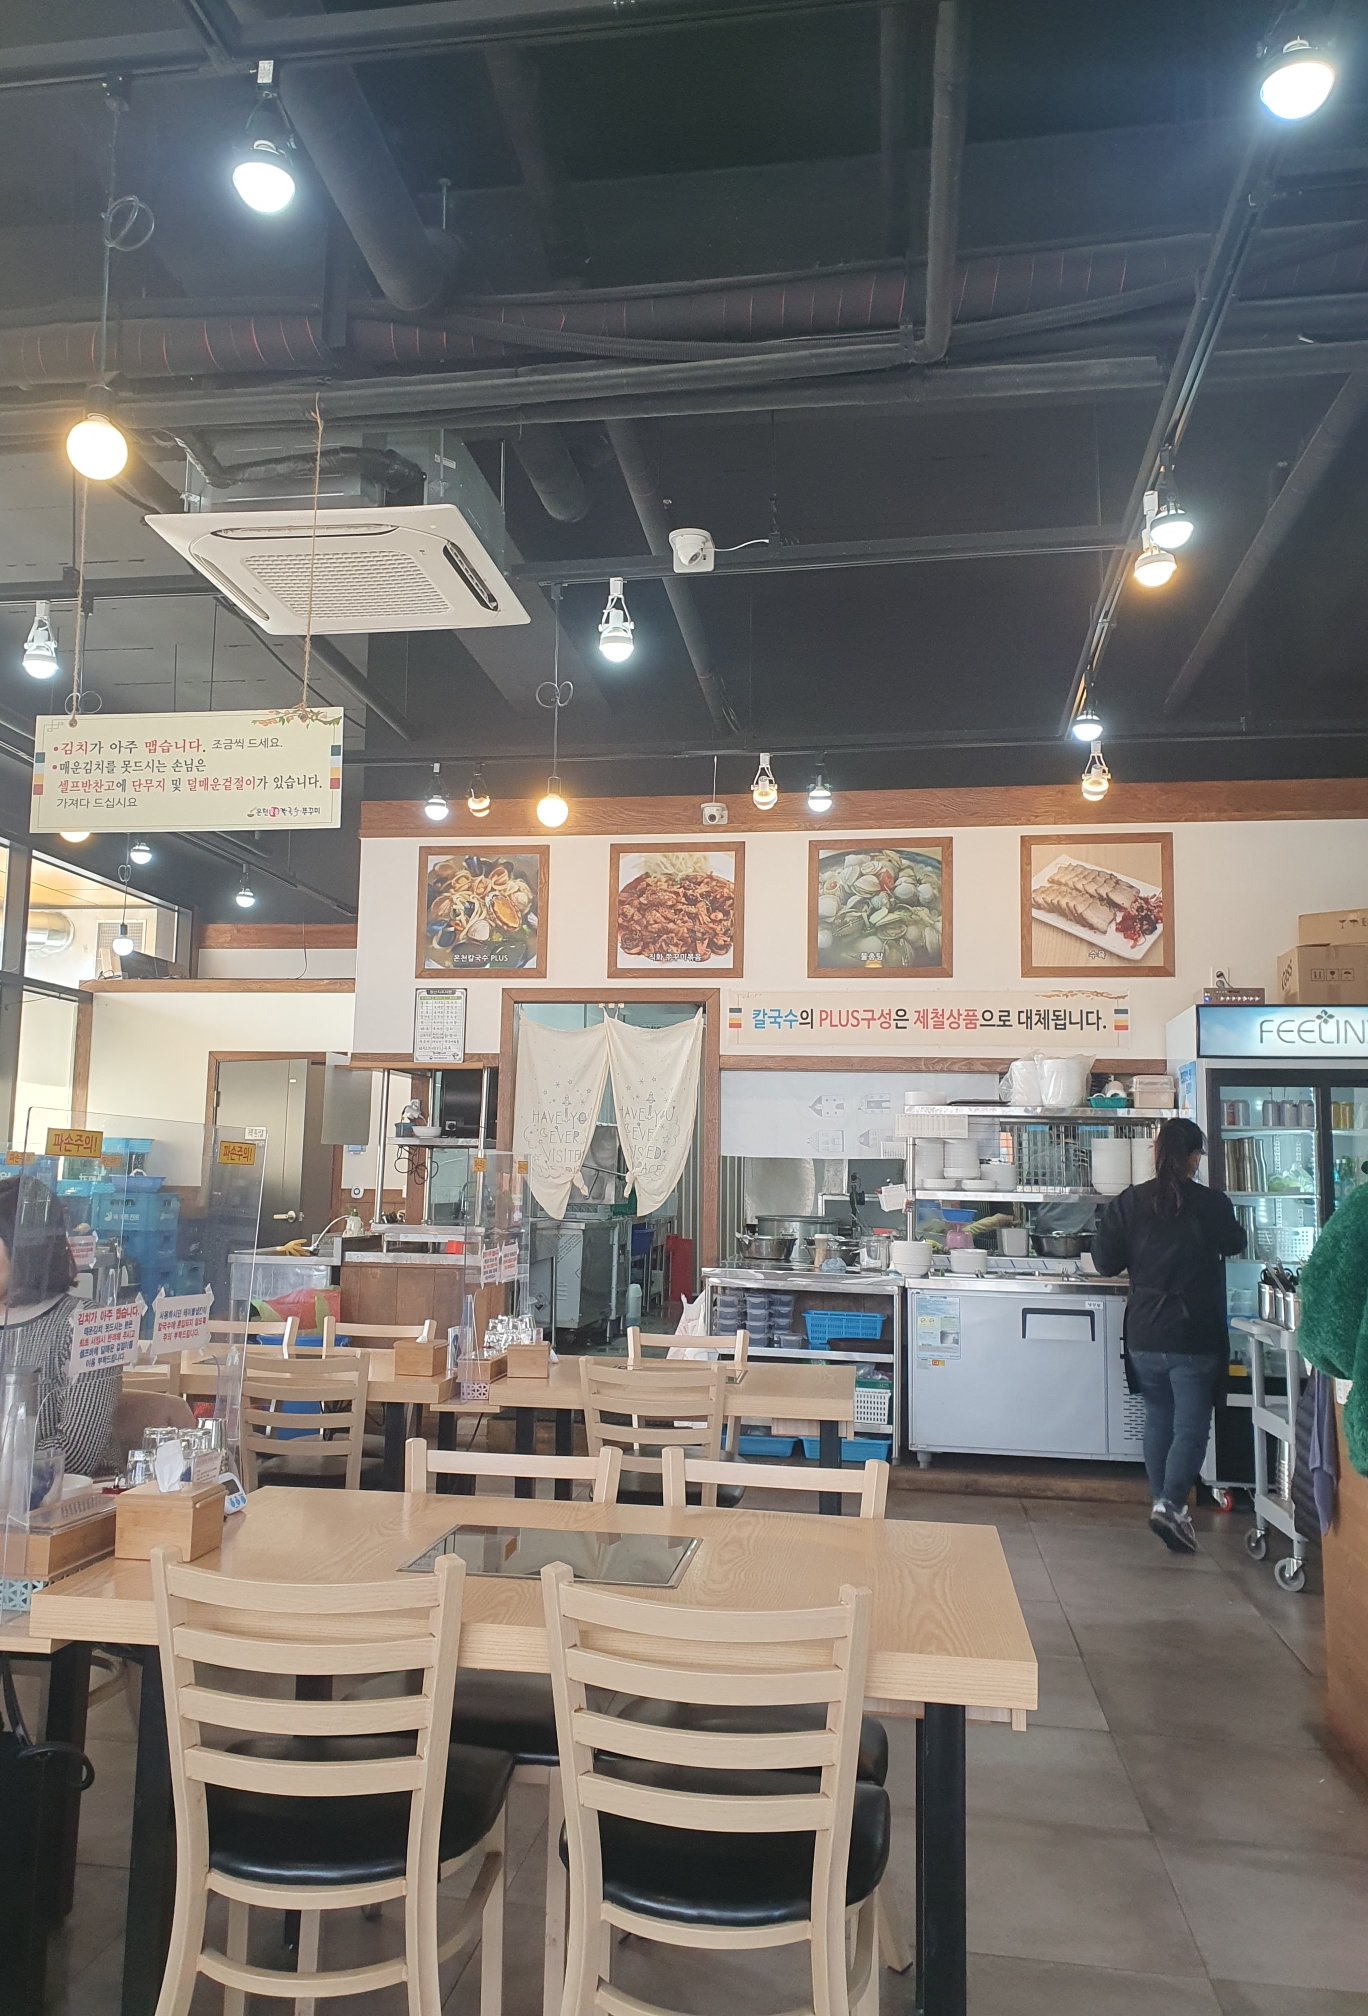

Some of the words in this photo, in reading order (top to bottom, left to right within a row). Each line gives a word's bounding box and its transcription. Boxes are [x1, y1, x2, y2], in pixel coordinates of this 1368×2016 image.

[61, 740, 104, 755] 김치가
[110, 740, 139, 755] 아주
[144, 738, 206, 754] 맵습니다.
[212, 738, 244, 750] 조금씩
[247, 737, 283, 749] 드세요.
[59, 760, 117, 774] 매운김치를
[121, 759, 167, 774] 못드시는
[171, 758, 206, 773] 손님은
[58, 778, 127, 793] 셀프반찬고에
[132, 778, 165, 793] 단무지
[171, 778, 181, 792] 및
[273, 774, 322, 790] 있습니다.
[57, 797, 90, 809] 가져다
[93, 797, 138, 809] 드십시요
[453, 954, 489, 962] 온천칼국수
[490, 954, 509, 962] PLUS
[752, 1007, 814, 1031] 칼국수의
[819, 1008, 909, 1031] PLUS구성은
[913, 1008, 1013, 1031] 제철상품으로
[1017, 1008, 1107, 1031] 대체됩니다.
[532, 1110, 562, 1124] HAVE
[53, 1133, 98, 1153] 파손주의!
[549, 1127, 580, 1144] EVER
[222, 1145, 253, 1162] 파손주의!
[78, 1311, 97, 1325] 김치가
[100, 1309, 113, 1322] 아주
[115, 1305, 139, 1320] 맵습니다.
[104, 1322, 123, 1333] 못드시는
[162, 1332, 172, 1342] 주의
[85, 1357, 96, 1368] 이용
